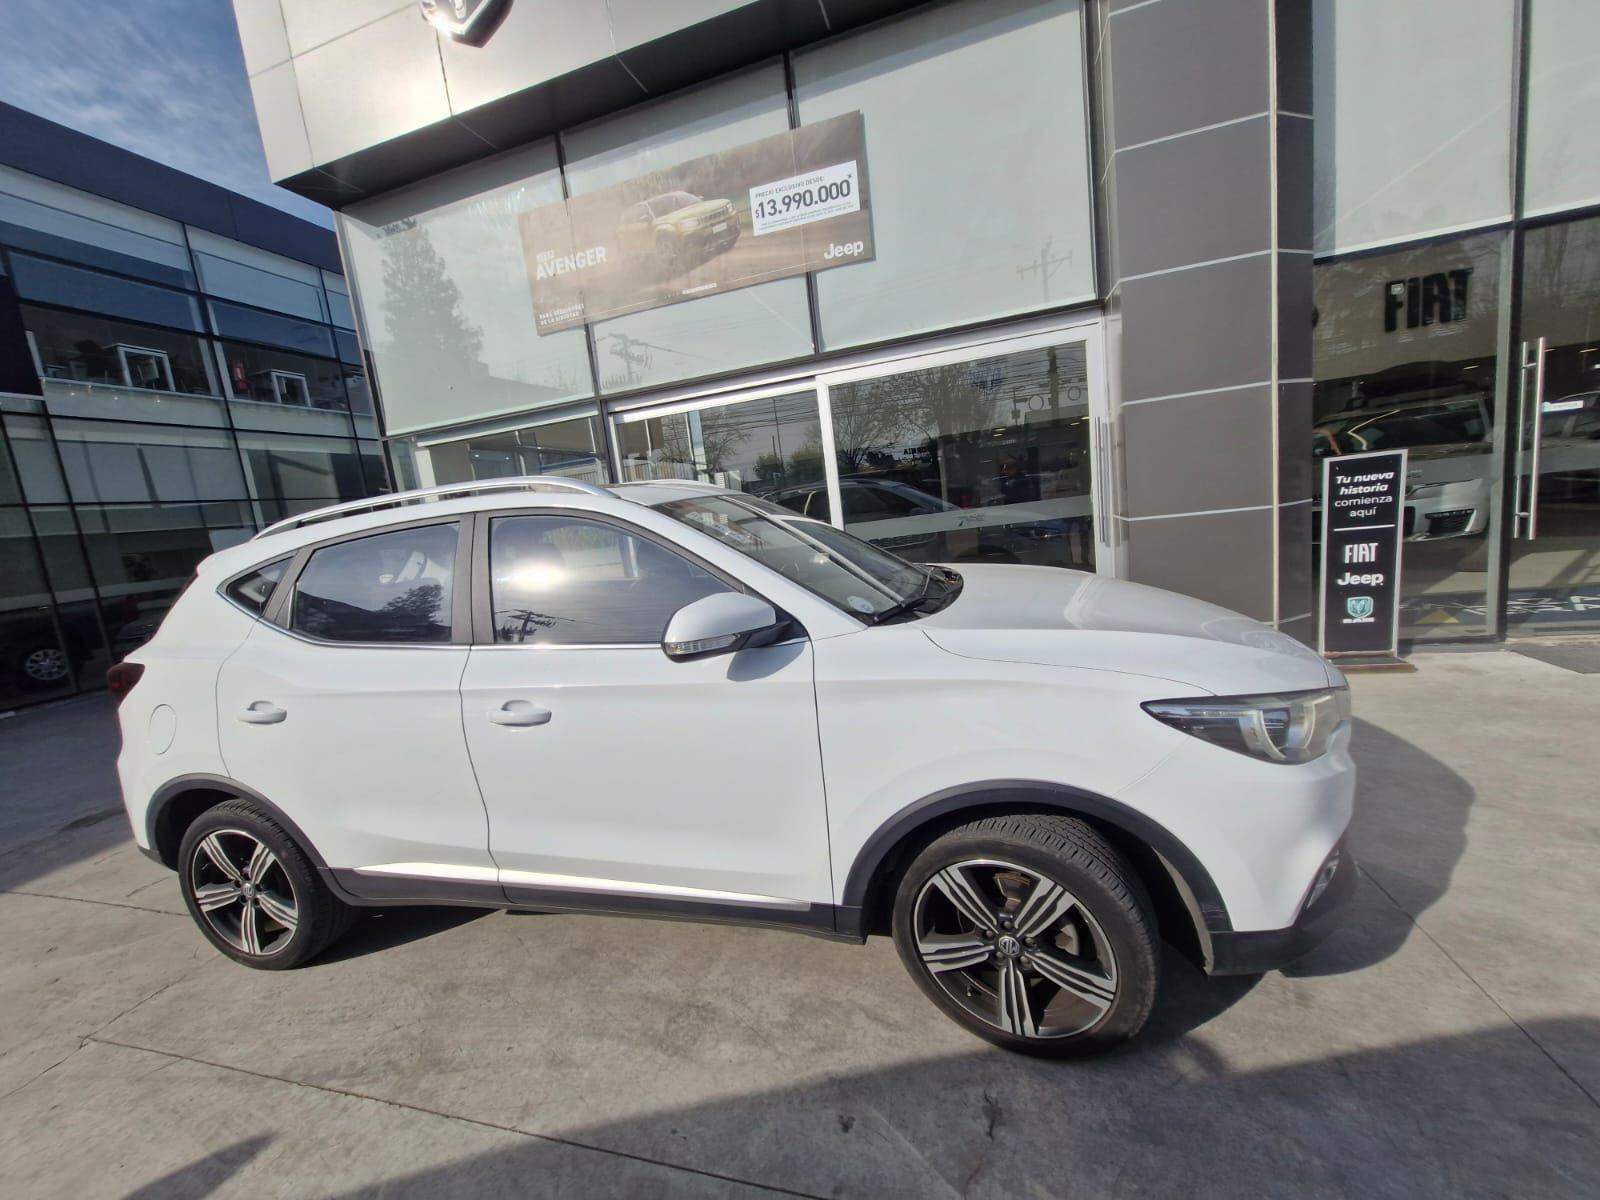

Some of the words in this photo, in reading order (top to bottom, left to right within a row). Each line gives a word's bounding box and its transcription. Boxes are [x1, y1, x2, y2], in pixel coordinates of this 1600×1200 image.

[824, 240, 864, 259] Jeep
[536, 246, 608, 280] AVENGER
[1384, 267, 1474, 333] FIAT
[1336, 475, 1351, 484] Tu
[1353, 471, 1395, 483] nueva
[1339, 482, 1389, 495] historia
[1334, 495, 1393, 507] comienza
[1349, 507, 1377, 517] aquí
[1344, 542, 1379, 564] FIAT
[1336, 572, 1384, 587] Jeep
